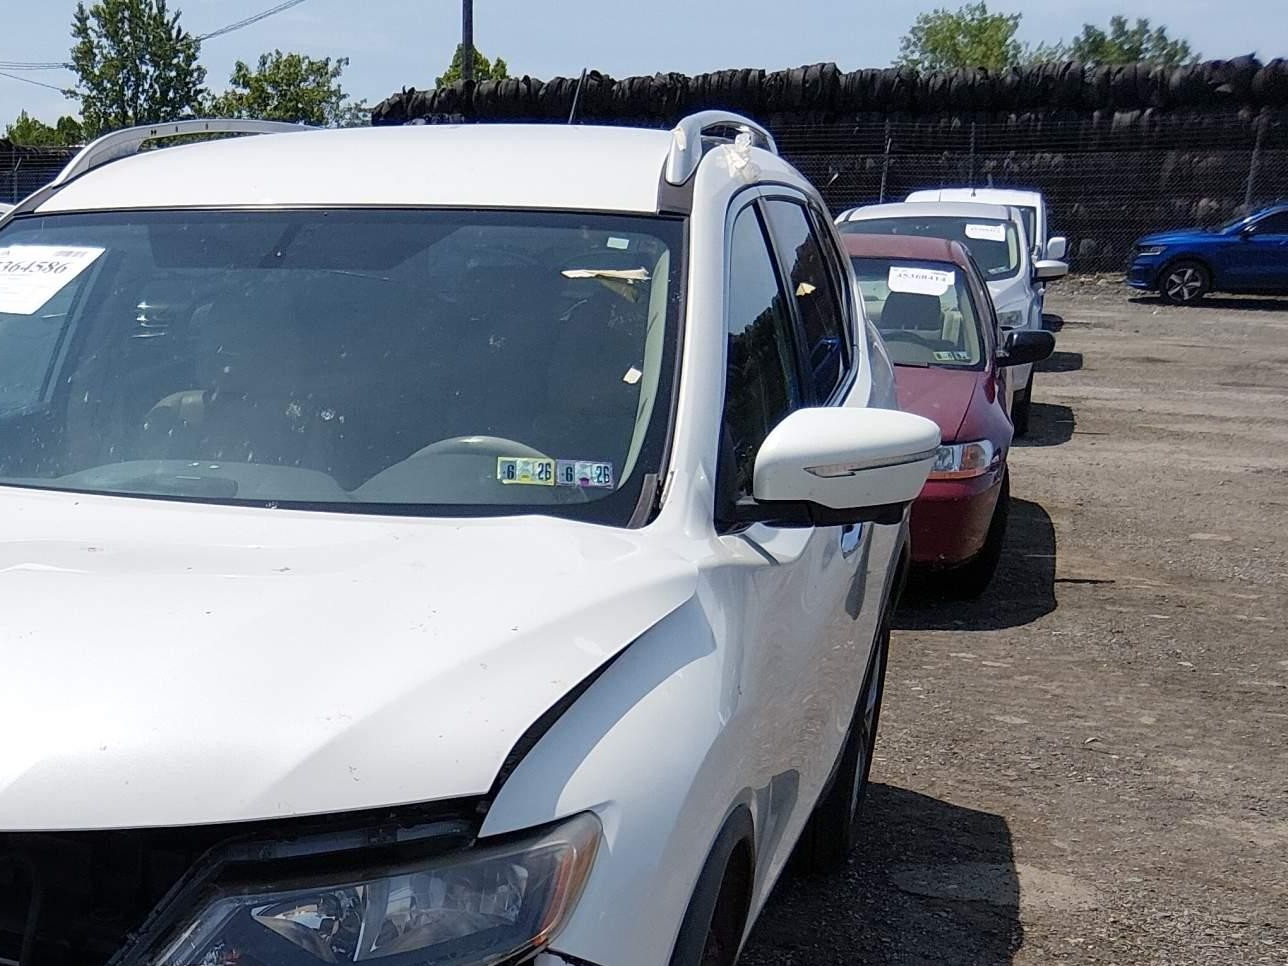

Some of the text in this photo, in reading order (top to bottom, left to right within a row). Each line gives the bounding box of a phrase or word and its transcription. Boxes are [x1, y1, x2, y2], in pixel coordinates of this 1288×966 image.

[507, 462, 552, 481] 6 26
[566, 465, 610, 483] 6 26
